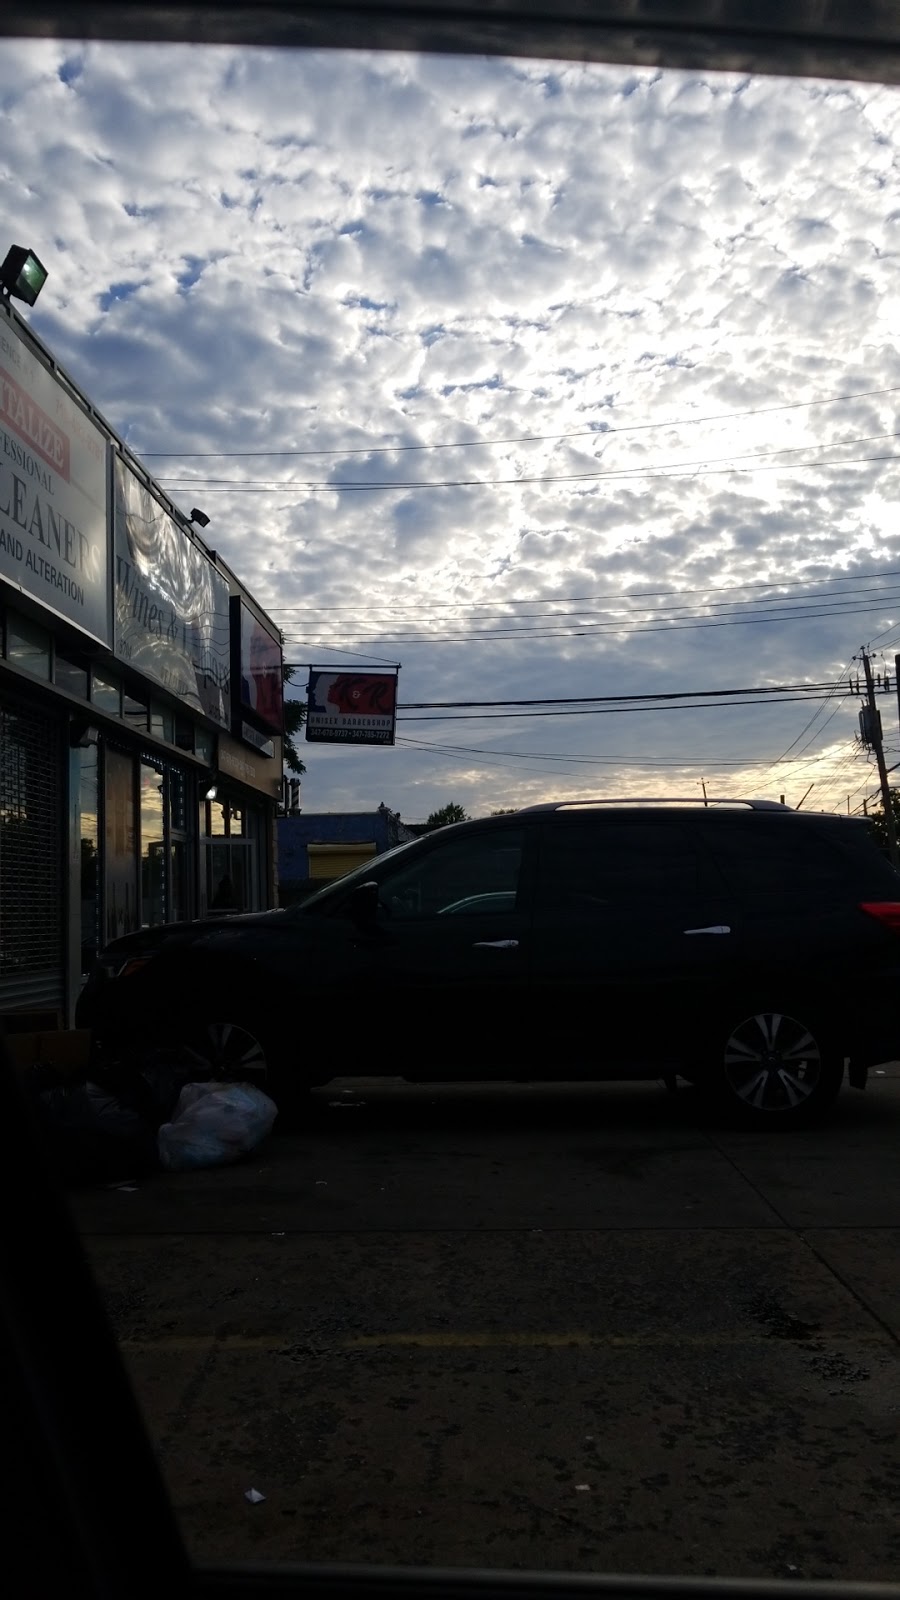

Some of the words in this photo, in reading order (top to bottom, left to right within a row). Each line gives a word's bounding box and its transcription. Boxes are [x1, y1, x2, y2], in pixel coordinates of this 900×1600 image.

[0, 430, 54, 496] ESSIONAL
[0, 529, 23, 562] AND
[25, 549, 84, 606] ALTERATION
[116, 554, 164, 641] Wines
[310, 716, 338, 725] UNISEX
[342, 718, 391, 727] BARBERSHOP
[352, 690, 361, 699] &
[362, 681, 392, 714] R
